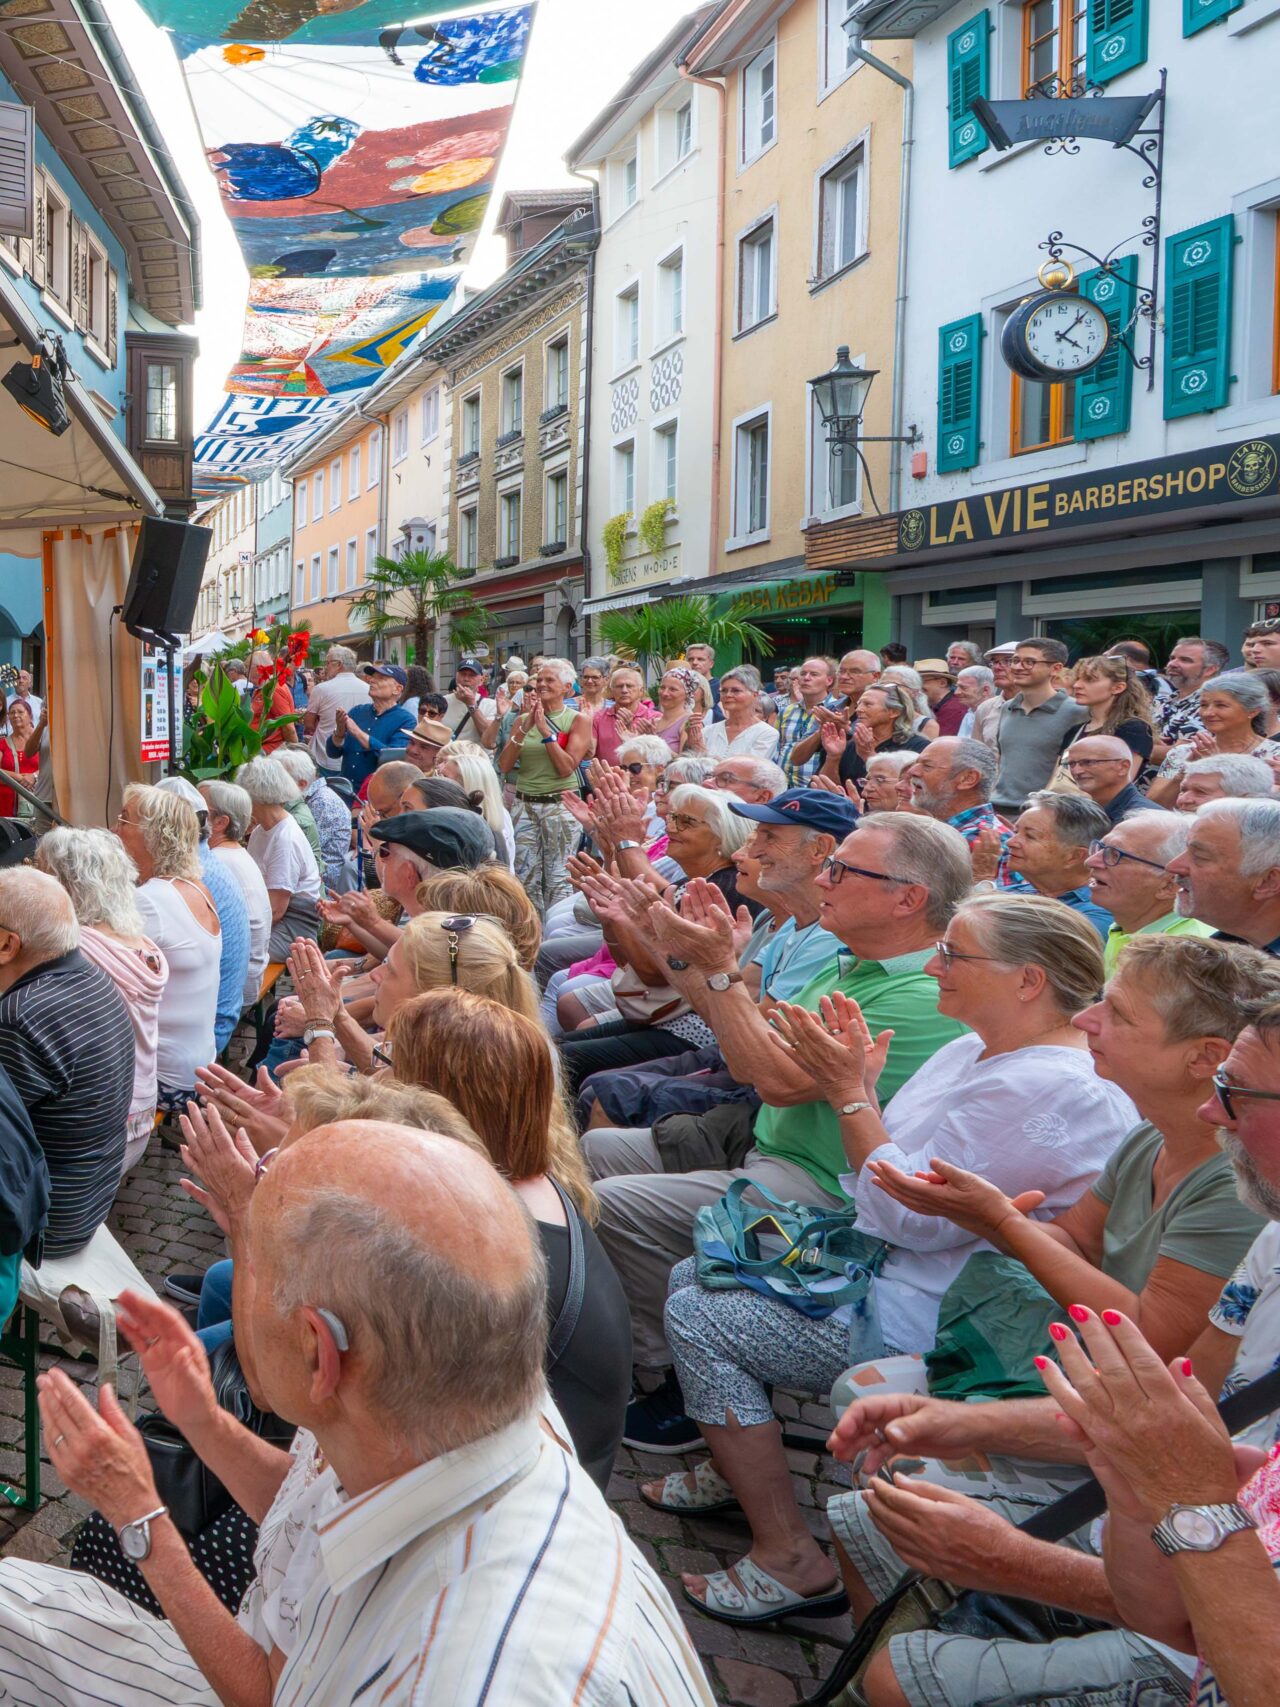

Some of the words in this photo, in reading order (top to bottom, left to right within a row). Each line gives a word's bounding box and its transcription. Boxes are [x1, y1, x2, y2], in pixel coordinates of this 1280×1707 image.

[1236, 446, 1249, 458] LA
[1251, 443, 1267, 452] VIE
[930, 502, 974, 546] LA
[985, 484, 1051, 536] VIE
[1055, 463, 1226, 517] BARBERSHOP
[776, 575, 838, 608] KEBAP
